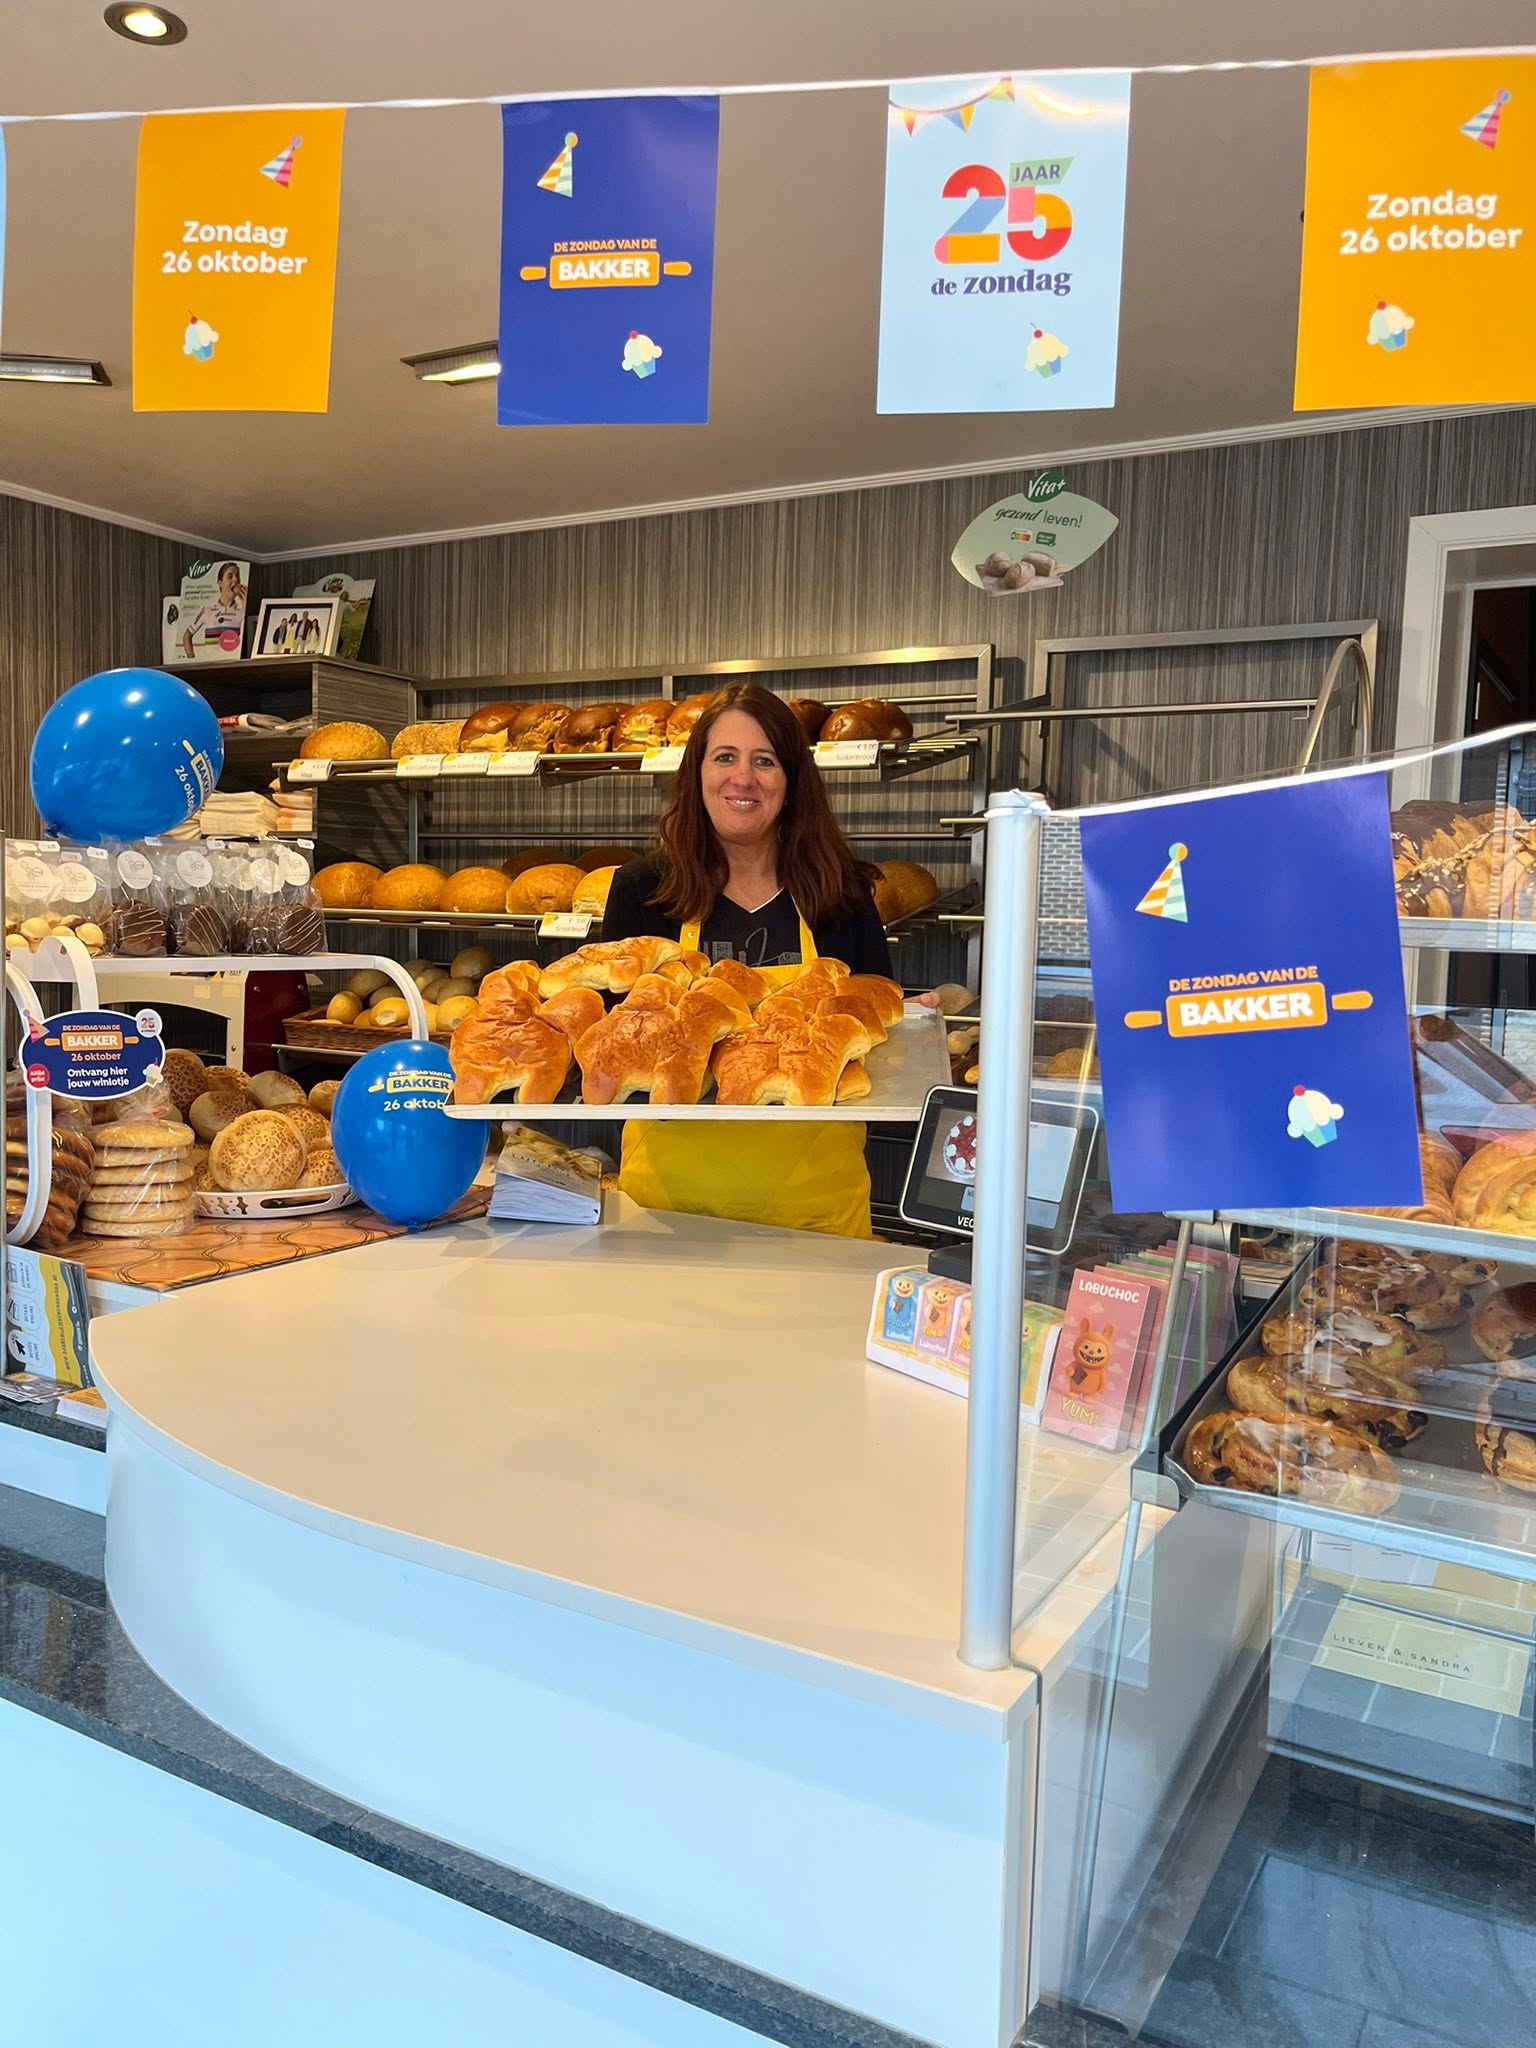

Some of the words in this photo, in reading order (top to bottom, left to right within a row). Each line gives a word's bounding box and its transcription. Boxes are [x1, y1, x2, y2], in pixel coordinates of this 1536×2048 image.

[1012, 164, 1061, 182] JAAR
[933, 160, 1073, 265] 25
[1366, 188, 1498, 220] Zondag
[182, 220, 289, 249] Zondag
[553, 242, 568, 252] DE
[569, 240, 616, 252] ZONDAG
[617, 239, 641, 250] VAN
[642, 238, 657, 249] DE
[1339, 227, 1379, 255] 26
[1386, 223, 1523, 251] oktober
[162, 250, 192, 273] 26
[197, 250, 308, 274] oktober
[558, 258, 650, 282] BAKKER
[930, 277, 957, 296] de
[963, 268, 1072, 297] zondag
[1027, 471, 1066, 499] Vita+
[993, 508, 1043, 522] gezond
[1043, 510, 1084, 528] leven!
[836, 753, 876, 761] Suikerbrood
[174, 765, 189, 782] 26
[1168, 978, 1191, 992] DE
[1192, 971, 1259, 990] ZONDAG
[1259, 967, 1294, 983] VAN
[1295, 965, 1318, 980] DE
[1179, 992, 1313, 1027] BAKKER
[67, 1034, 119, 1047] BAKKER
[71, 1053, 83, 1062] 26
[84, 1052, 122, 1061] oktober
[66, 1068, 108, 1077] Ontvang
[110, 1066, 128, 1076] hier
[67, 1078, 92, 1089] jouw
[92, 1076, 130, 1087] winlotje
[393, 1079, 449, 1090] BAKKER
[384, 1100, 401, 1112] 26
[403, 1098, 445, 1110] oktob
[957, 1215, 974, 1228] VEC
[1078, 1279, 1140, 1304] LABUCHOC
[1061, 1396, 1099, 1425] YUM!
[1332, 1633, 1385, 1652] LIEVEN
[1393, 1648, 1402, 1656] &
[1410, 1653, 1471, 1673] SANDRA
